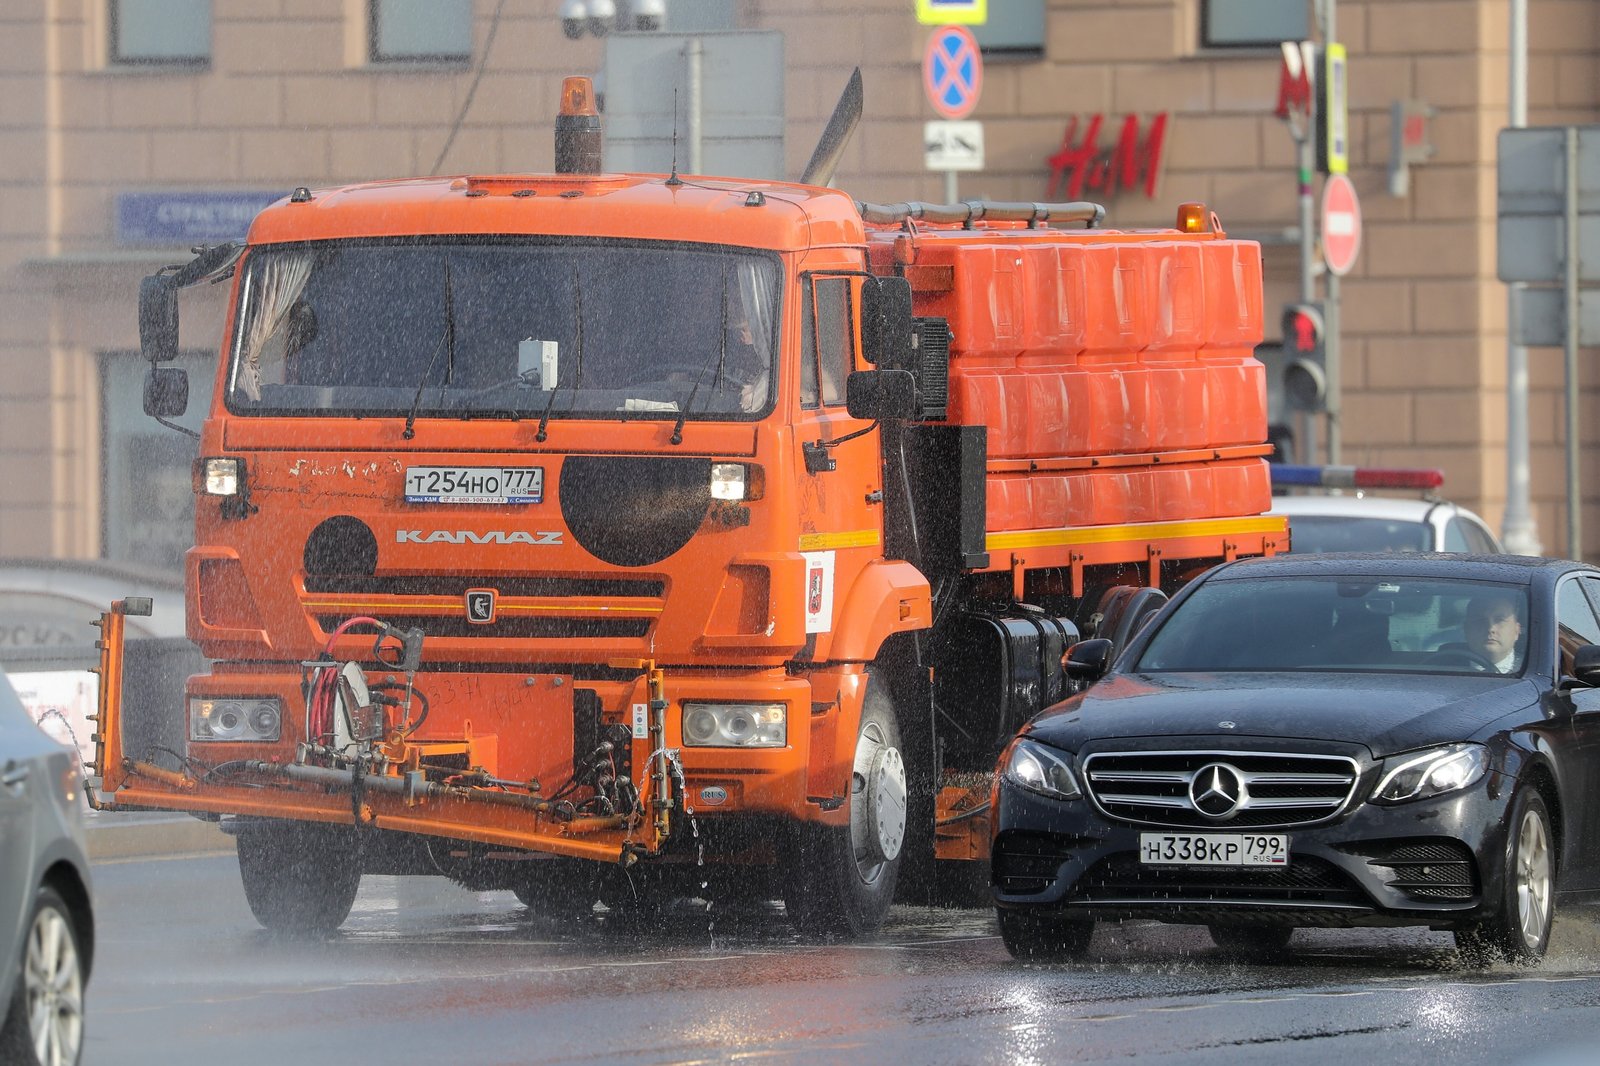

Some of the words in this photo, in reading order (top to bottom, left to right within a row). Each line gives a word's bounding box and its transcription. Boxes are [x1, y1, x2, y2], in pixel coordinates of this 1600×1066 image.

[413, 471, 499, 493] Т254НО
[503, 470, 536, 487] 777
[396, 530, 563, 545] KAMAZ
[1148, 836, 1238, 861] Н338КР
[1244, 836, 1280, 855] 799
